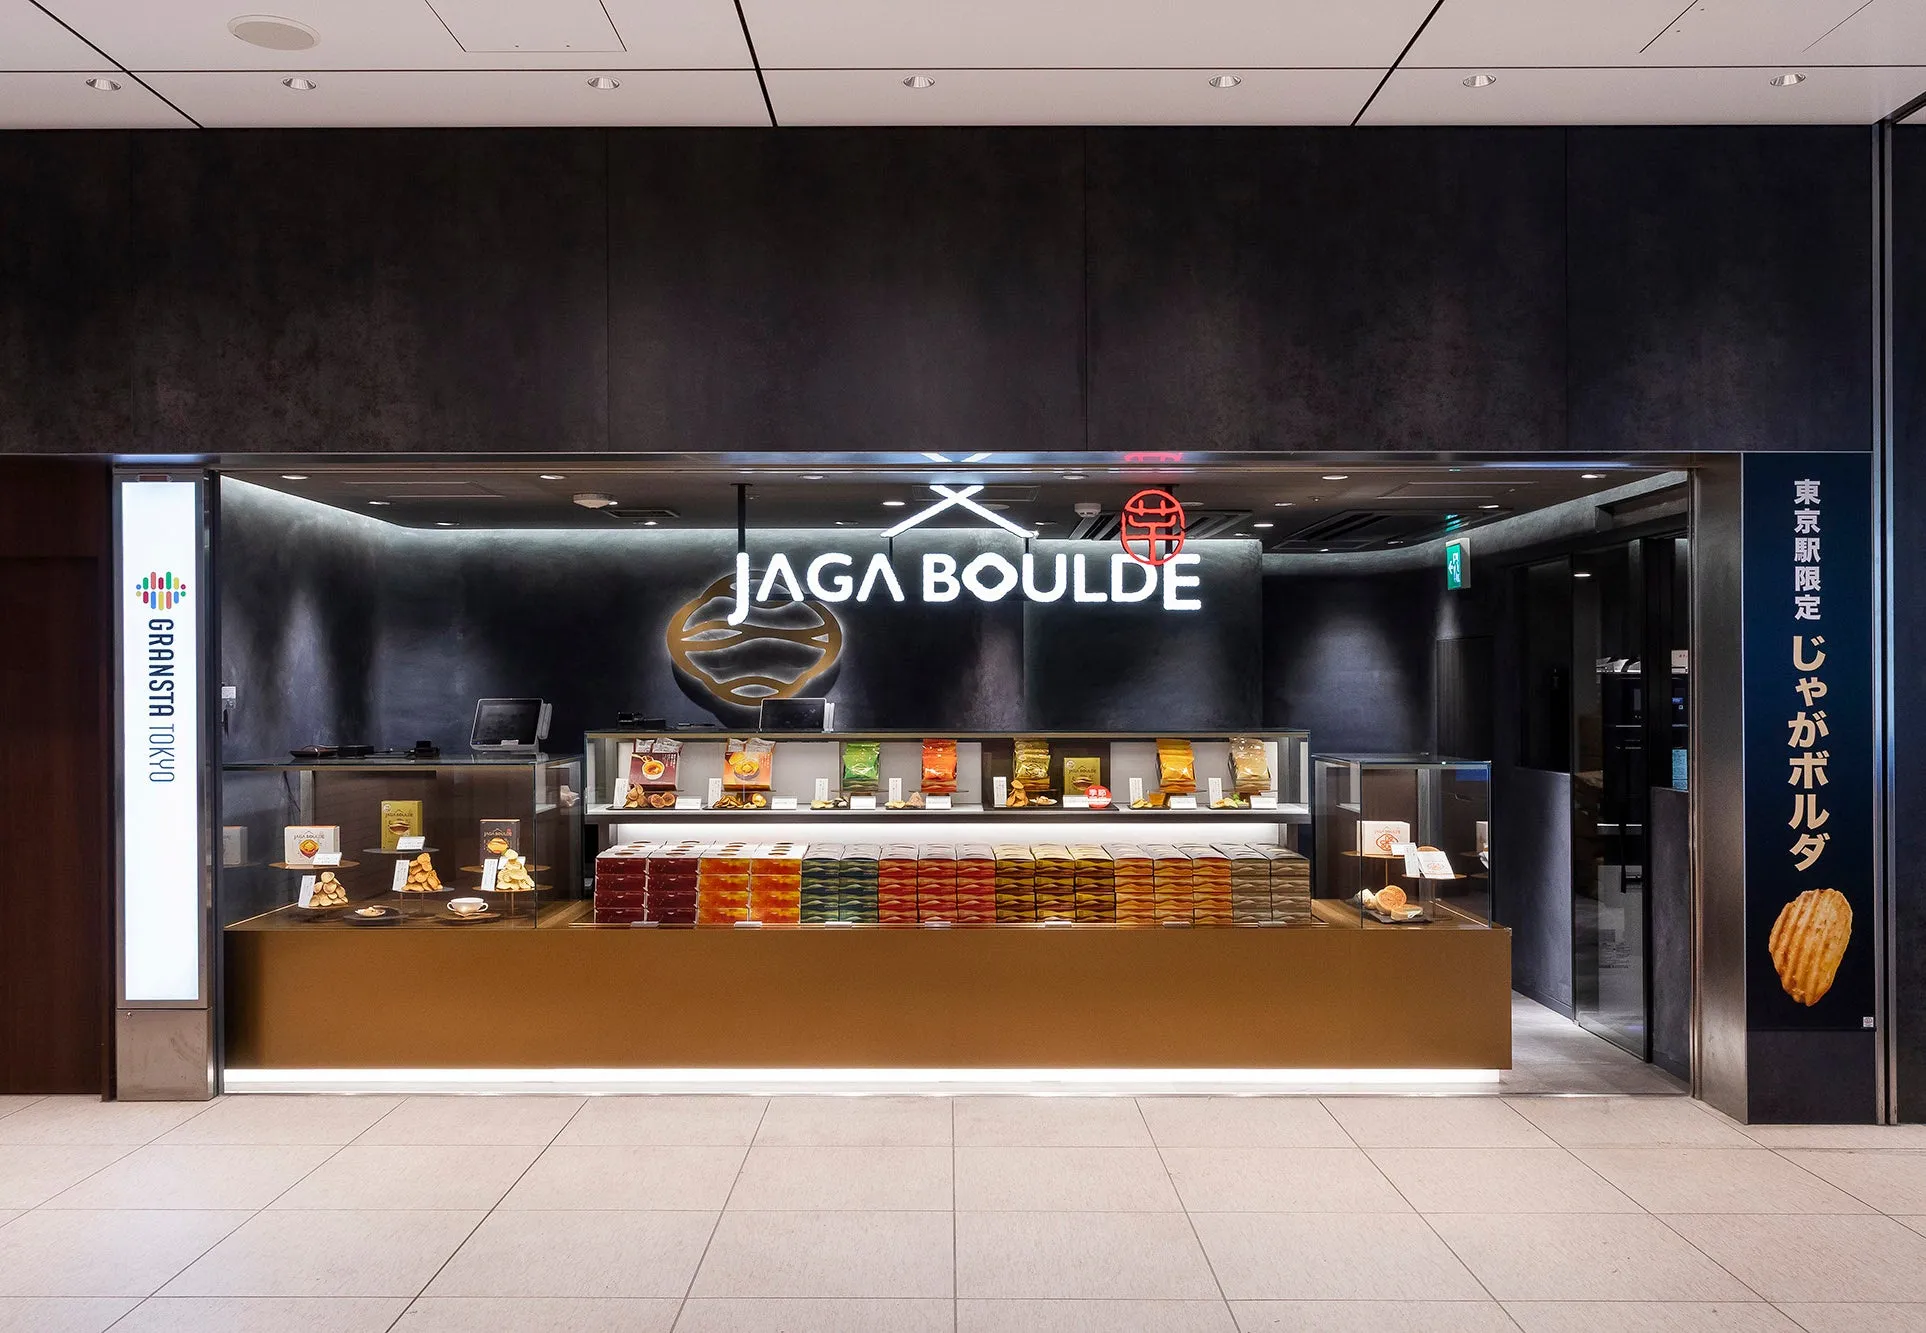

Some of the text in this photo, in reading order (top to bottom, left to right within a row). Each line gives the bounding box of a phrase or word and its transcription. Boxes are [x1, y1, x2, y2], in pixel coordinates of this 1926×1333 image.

[727, 552, 1202, 626] JAGA BOULDE
[148, 618, 175, 783] GRANSTA TOKYO
[1788, 479, 1831, 872] 東京駅限定 じゃがボルダ
